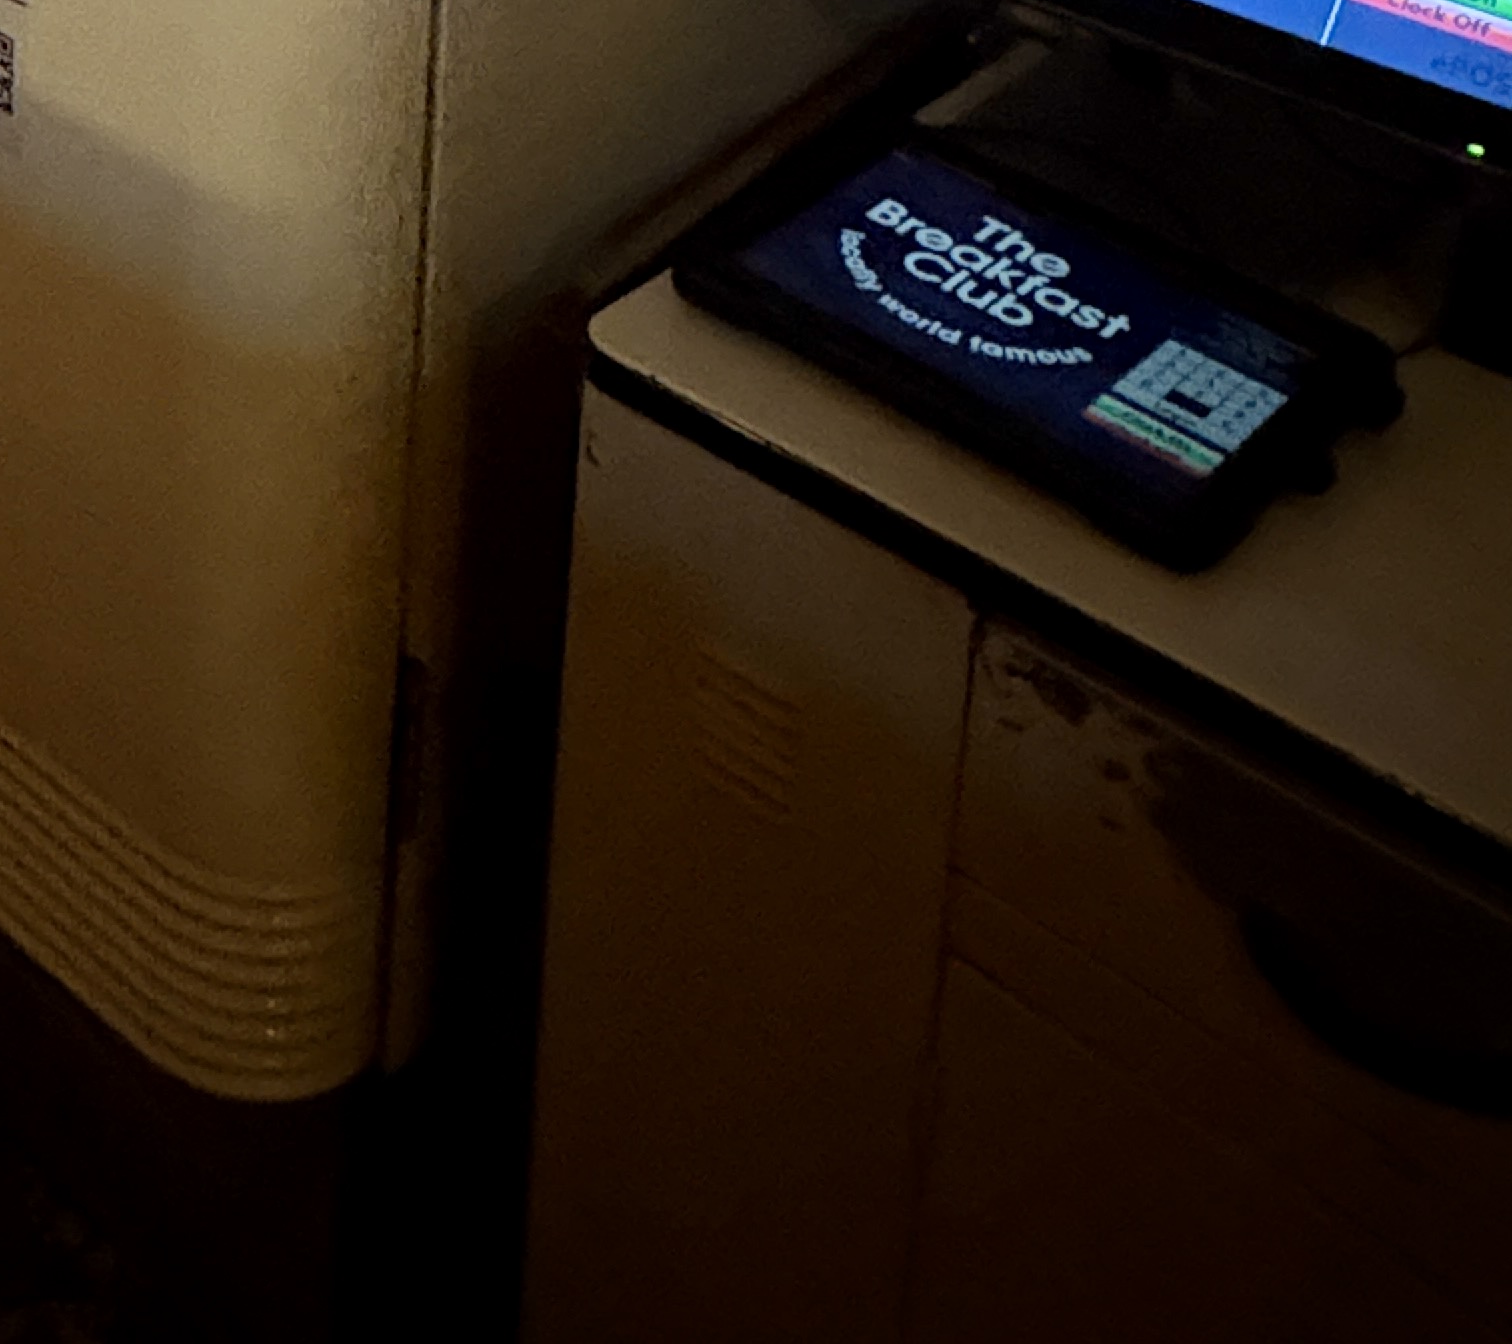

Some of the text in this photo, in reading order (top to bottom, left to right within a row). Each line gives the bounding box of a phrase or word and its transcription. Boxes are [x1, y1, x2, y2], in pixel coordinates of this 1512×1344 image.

[1454, 13, 1492, 38] Off
[866, 199, 1130, 339] Breakfast
[971, 215, 1070, 278] The
[903, 251, 1034, 328] Club
[877, 292, 961, 346] world
[969, 333, 1093, 366] famous
